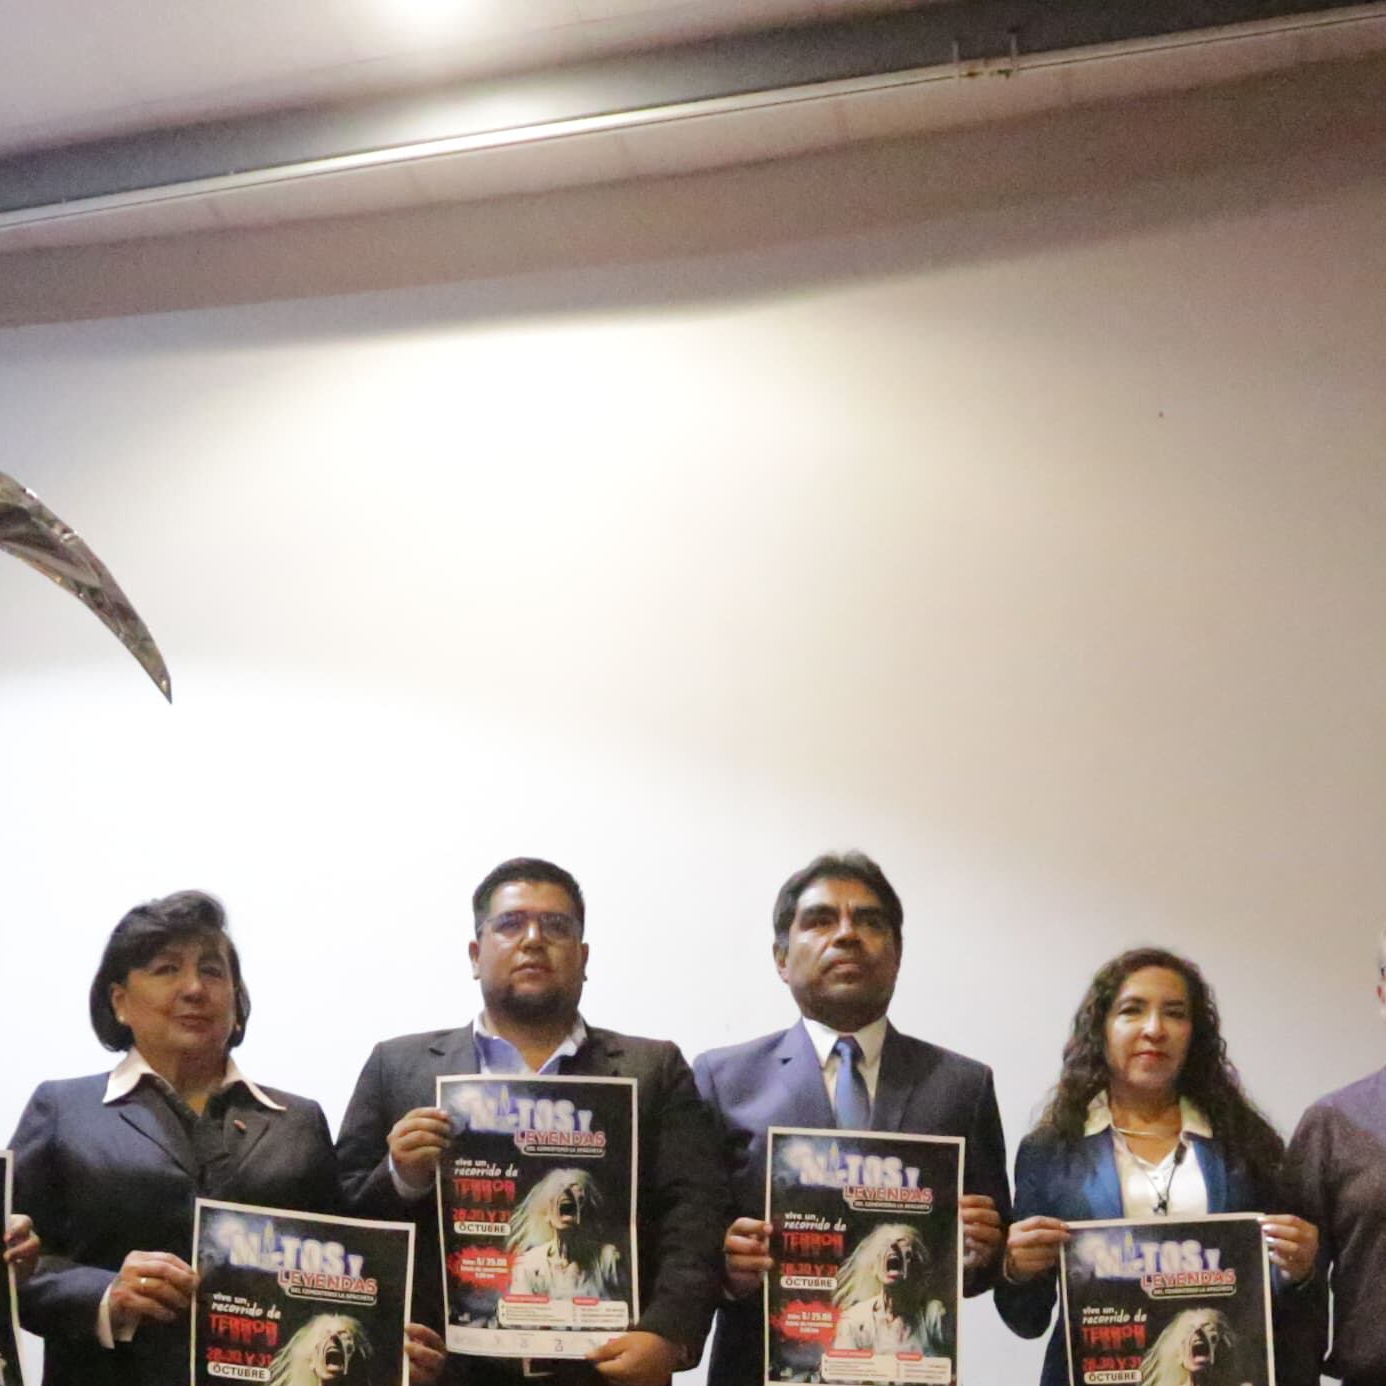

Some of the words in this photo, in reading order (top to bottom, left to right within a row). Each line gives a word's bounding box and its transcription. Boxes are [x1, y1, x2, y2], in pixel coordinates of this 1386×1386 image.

[514, 1129, 606, 1147] LEYENDAS
[455, 1158, 472, 1166] vive
[454, 1164, 502, 1177] recorrido
[505, 1164, 518, 1177] de
[452, 1178, 516, 1200] TERROR
[843, 1185, 933, 1203] LEYENDAS
[785, 1212, 802, 1220] vive
[459, 1223, 506, 1233] OCTUBRE
[784, 1217, 830, 1230] recorrido
[834, 1218, 847, 1231] de
[783, 1232, 843, 1252] TERROR
[278, 1269, 377, 1295] LEYENDAS
[785, 1278, 832, 1287] OCTUBRE
[1141, 1269, 1236, 1287] LEYENDAS
[213, 1293, 232, 1302] vive
[211, 1301, 263, 1317] recorrido
[266, 1305, 281, 1319] de
[1082, 1311, 1130, 1324] recorrido
[1134, 1309, 1147, 1322] de
[1083, 1307, 1100, 1315] vive
[210, 1314, 278, 1342] TERROR
[1082, 1325, 1146, 1348] TERROR
[213, 1363, 266, 1378] OCTUBRE
[1089, 1372, 1137, 1382] OCTUBRE
